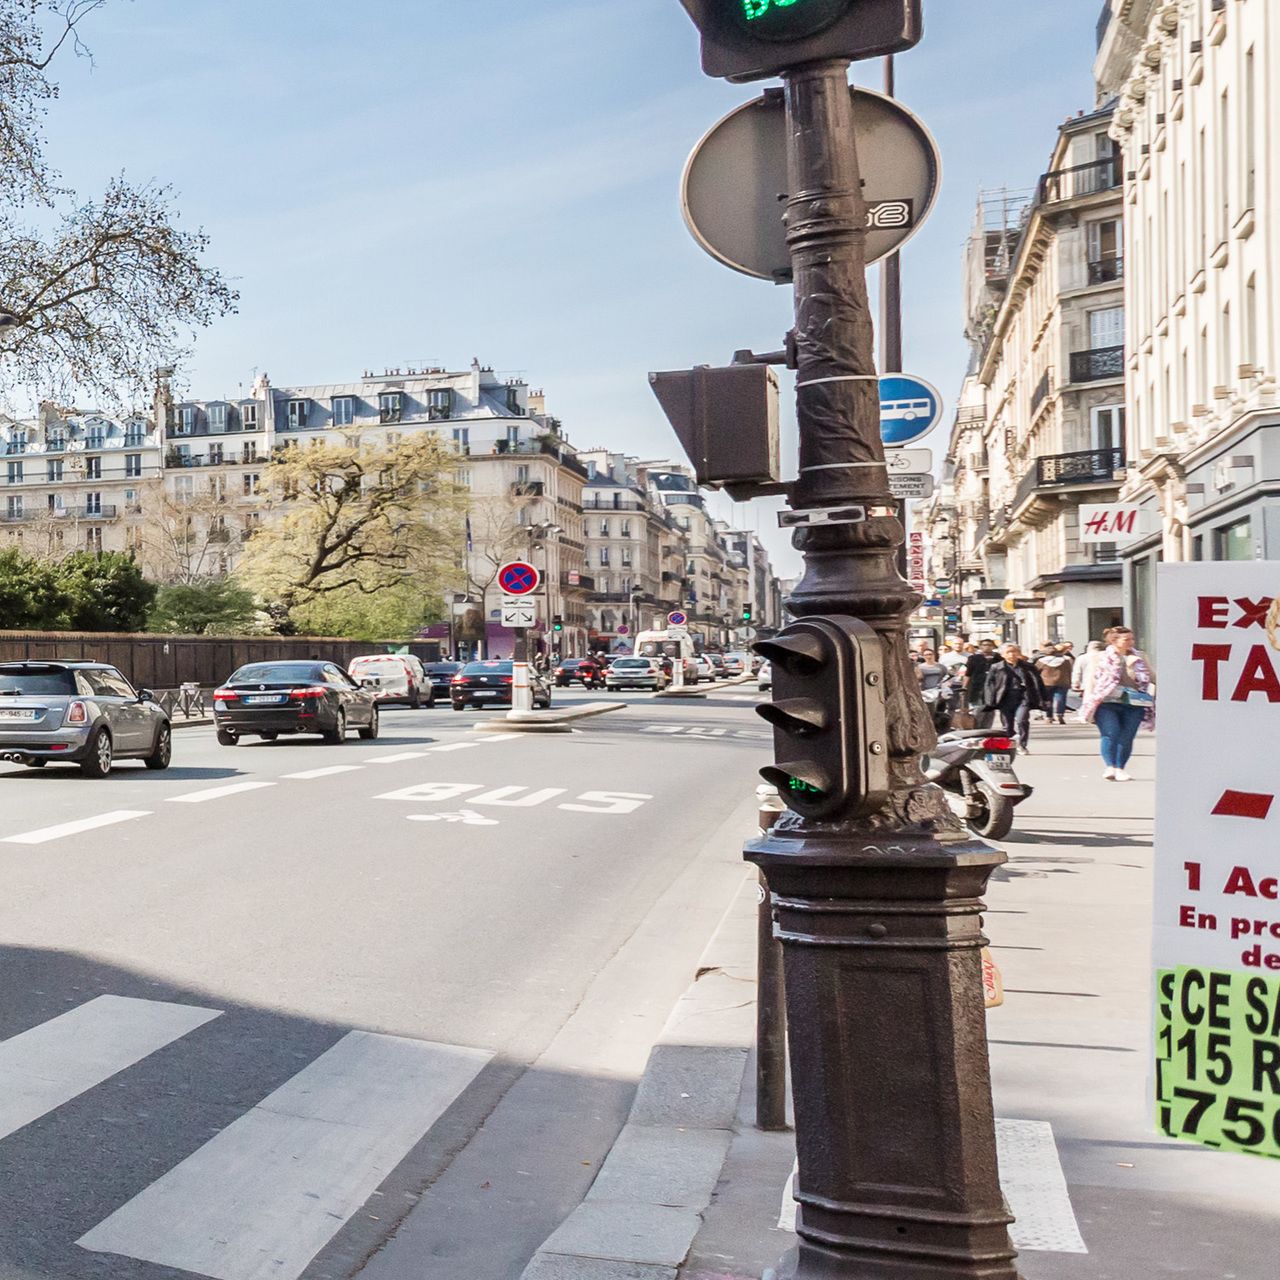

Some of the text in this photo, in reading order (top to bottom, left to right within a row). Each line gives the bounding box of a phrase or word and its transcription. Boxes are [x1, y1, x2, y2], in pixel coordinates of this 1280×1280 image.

[1085, 509, 1137, 535] H&M
[1192, 643, 1280, 703] TA
[370, 782, 654, 814] BUS
[1184, 861, 1280, 900] 1 Ac
[1179, 905, 1217, 930] En
[1173, 1086, 1280, 1147] 75
